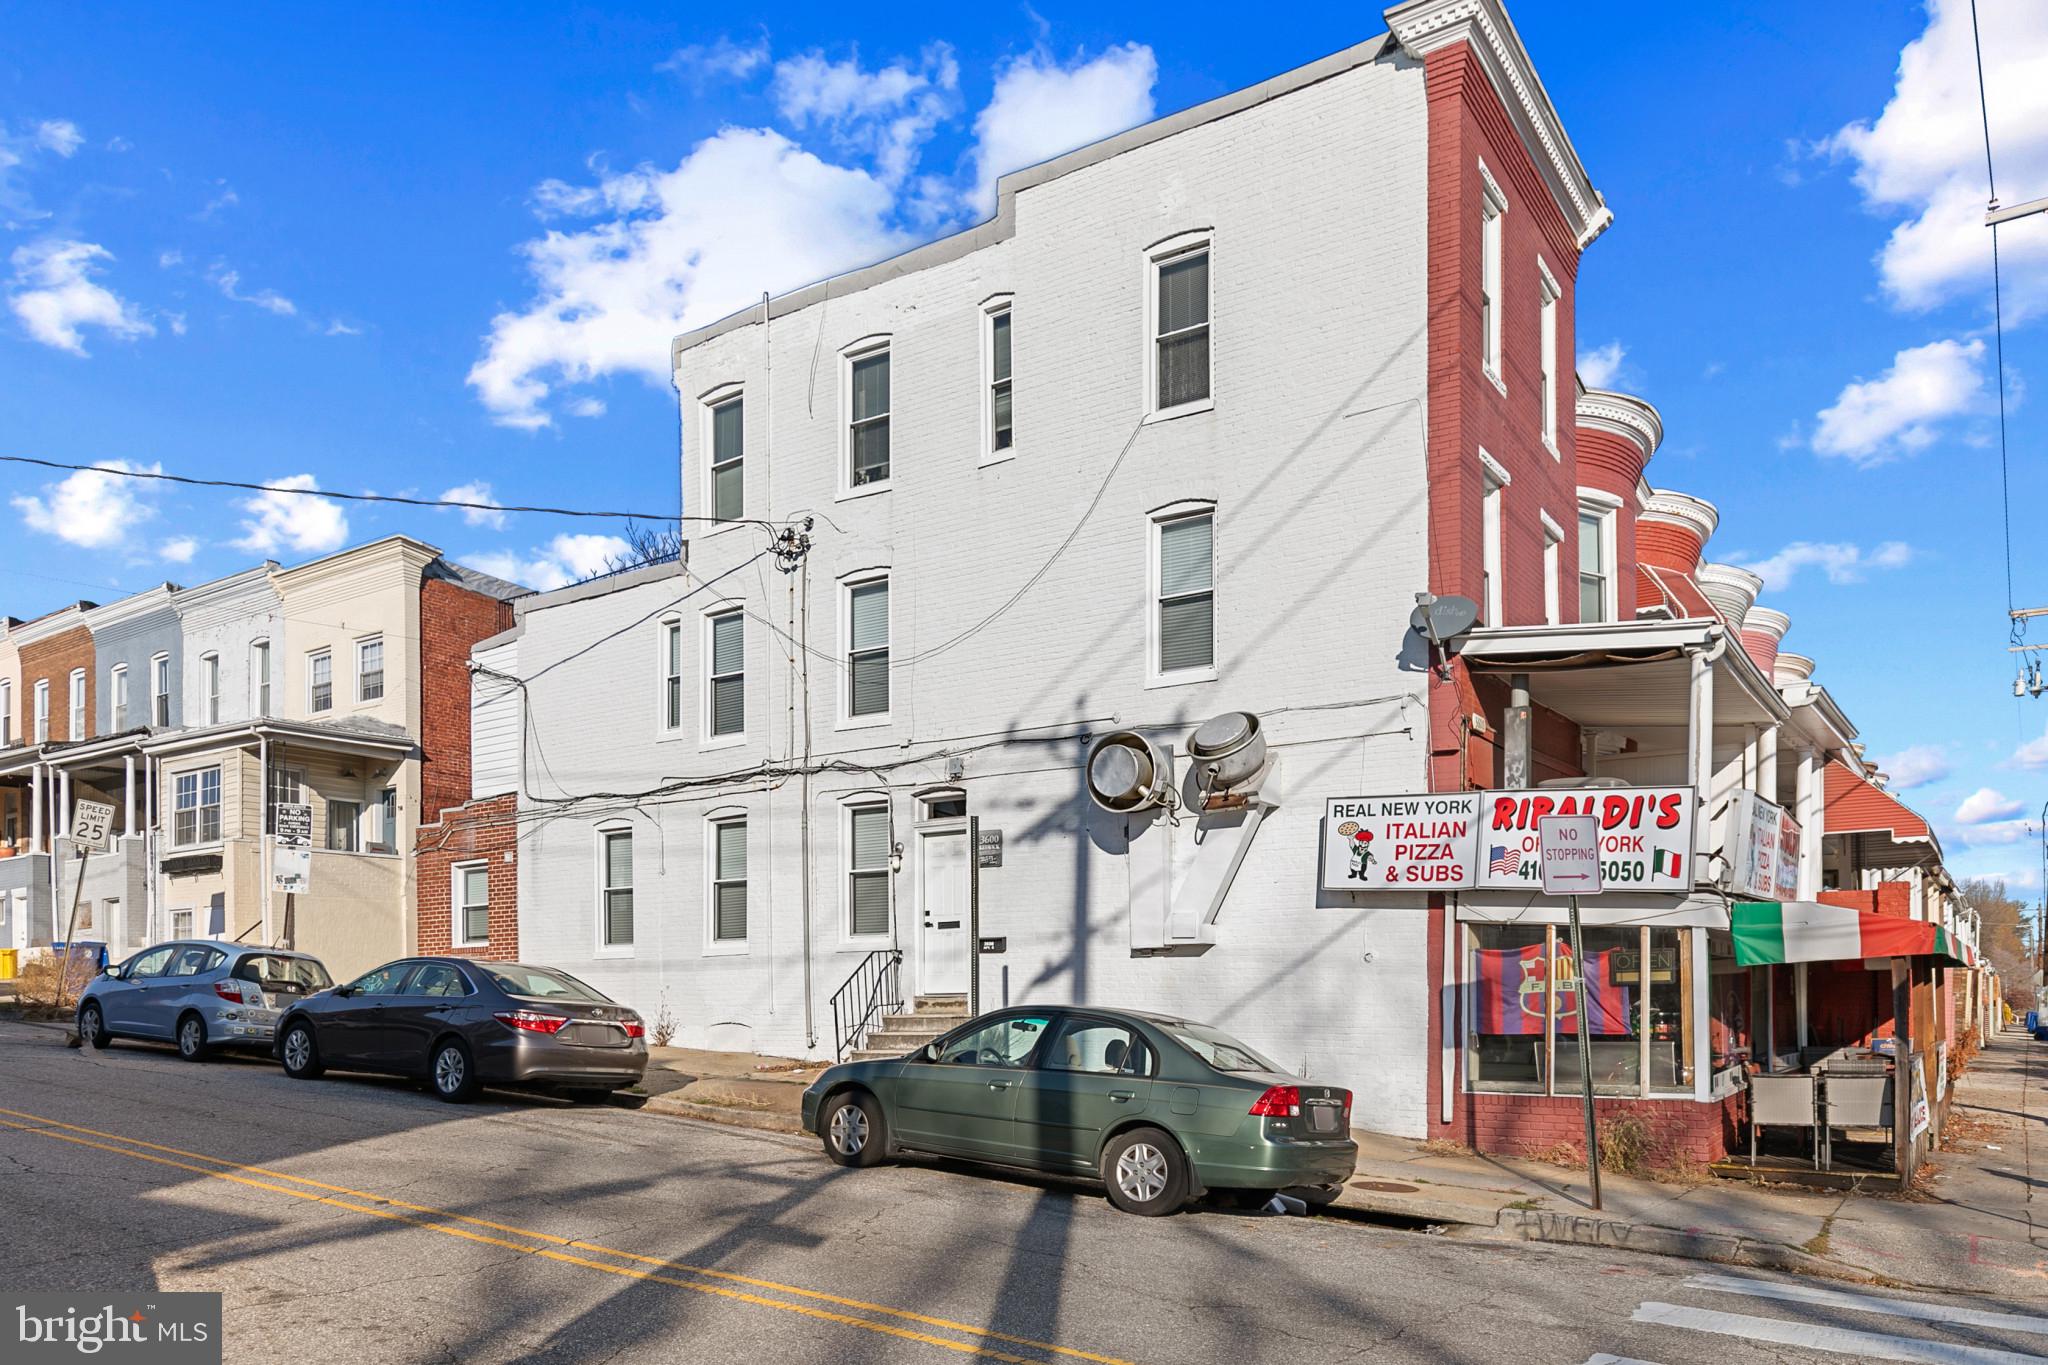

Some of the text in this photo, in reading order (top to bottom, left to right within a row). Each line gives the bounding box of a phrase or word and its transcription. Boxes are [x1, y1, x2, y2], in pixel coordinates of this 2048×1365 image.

[79, 803, 111, 816] SPEED
[1333, 799, 1473, 818] REAL NEW YORK
[80, 812, 106, 823] LIMIT
[279, 814, 310, 823] PARKING
[76, 821, 104, 840] 25
[1386, 820, 1467, 840] ITALIAN
[1558, 828, 1578, 841] NO
[1394, 843, 1454, 861] PIZZA
[1546, 848, 1595, 861] STOPPING
[1385, 864, 1464, 883] & SUBS
